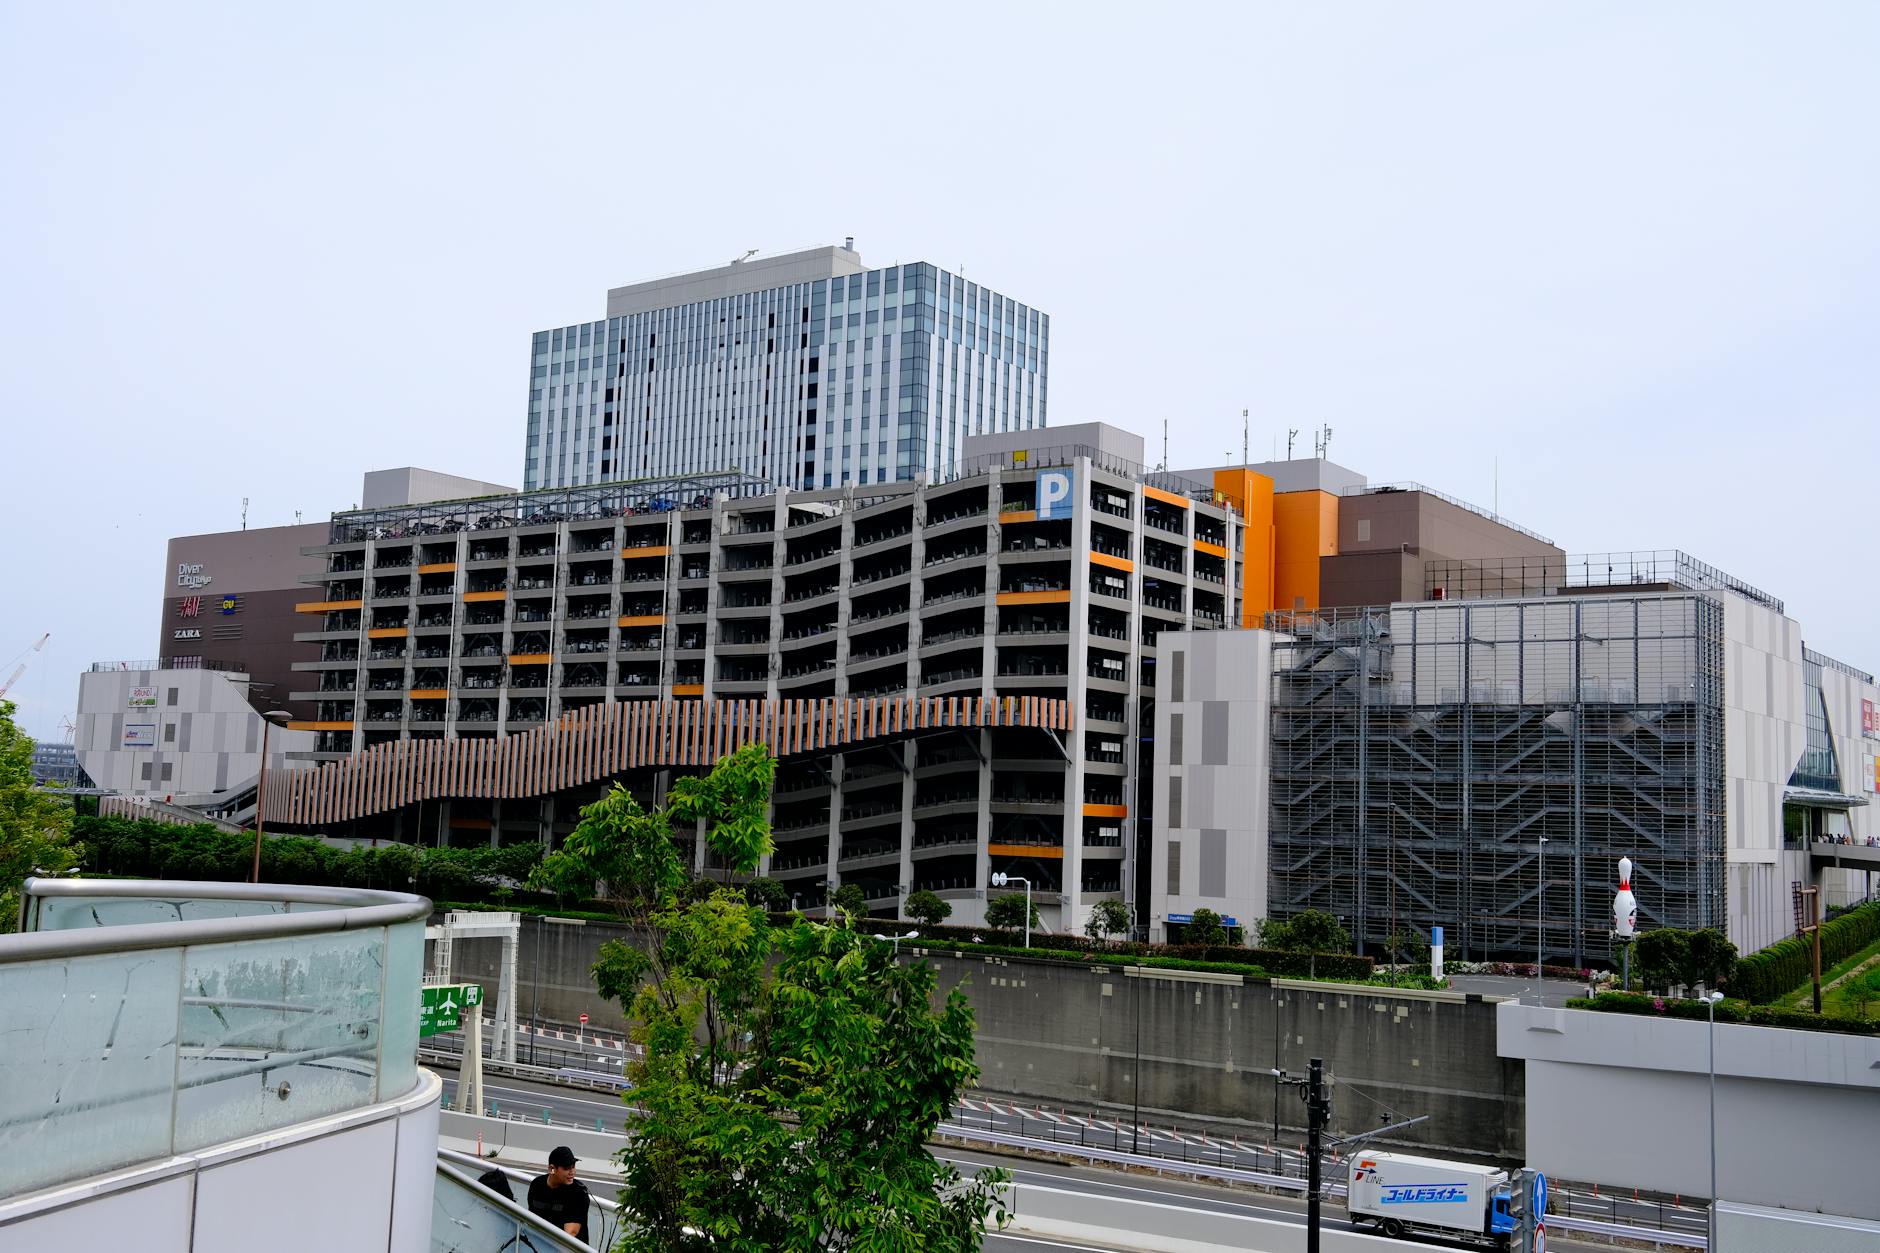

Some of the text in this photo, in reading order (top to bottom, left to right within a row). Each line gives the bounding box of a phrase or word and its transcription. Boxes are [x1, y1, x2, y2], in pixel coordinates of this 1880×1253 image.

[1040, 473, 1069, 517] P
[179, 563, 203, 574] Diver
[223, 600, 235, 609] GU
[174, 629, 200, 638] ZARA
[437, 1019, 457, 1027] Narita
[1366, 1175, 1384, 1184] LINE
[1387, 1188, 1464, 1201] コールドライナー
